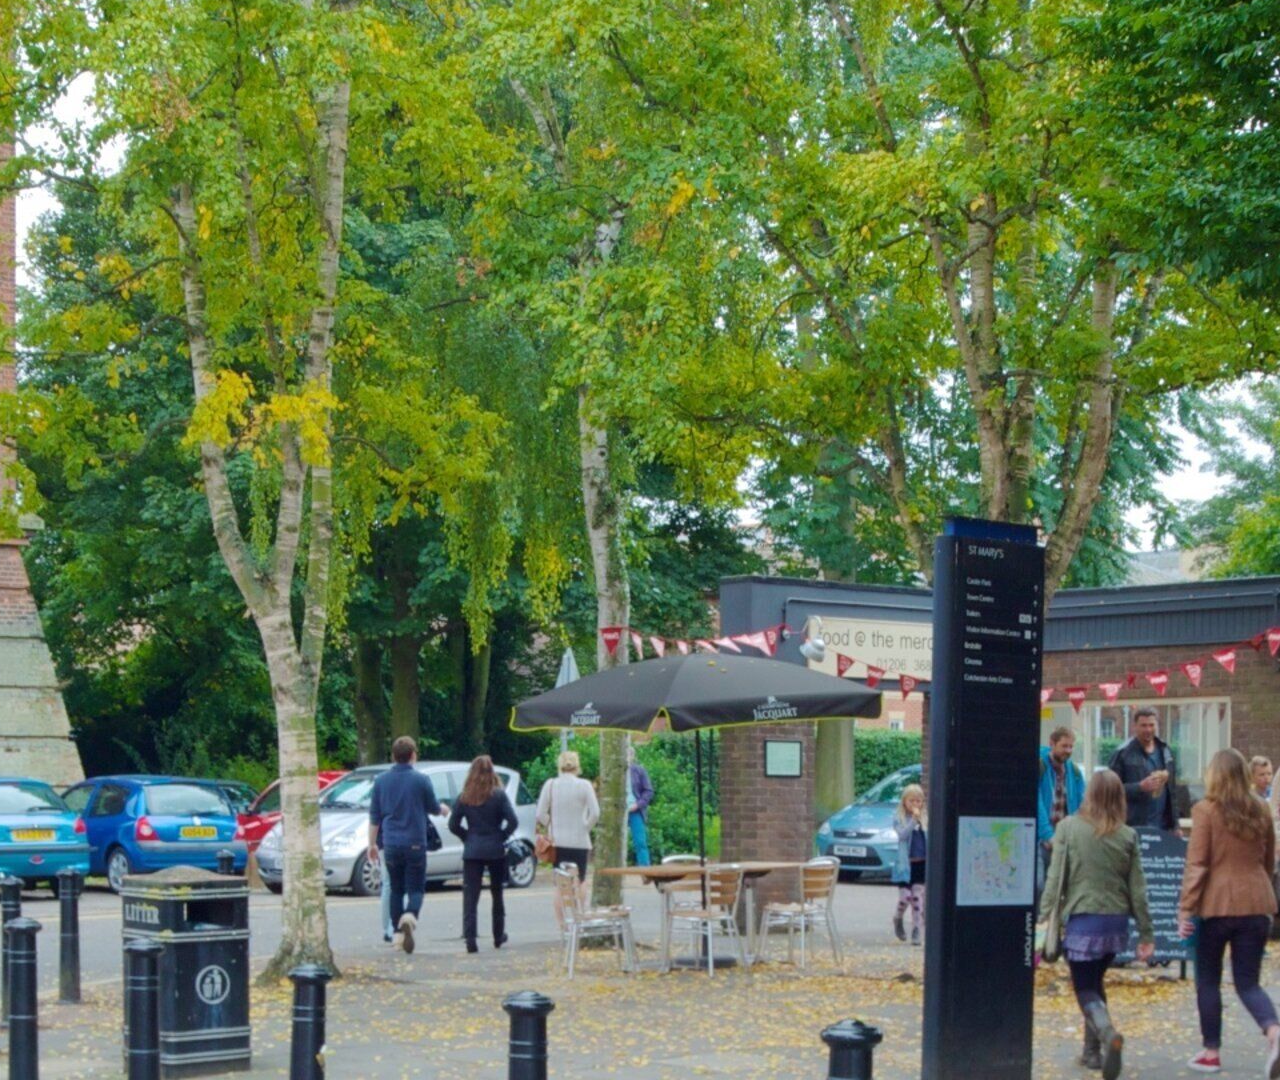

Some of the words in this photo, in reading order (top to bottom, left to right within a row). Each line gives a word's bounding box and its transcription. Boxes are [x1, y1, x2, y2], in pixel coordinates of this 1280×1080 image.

[855, 631, 866, 647] @
[872, 630, 894, 648] the
[753, 707, 798, 721] JACQUART
[125, 904, 160, 924] LITTER
[1025, 911, 1033, 933] MAP
[1024, 934, 1032, 967] POINT
